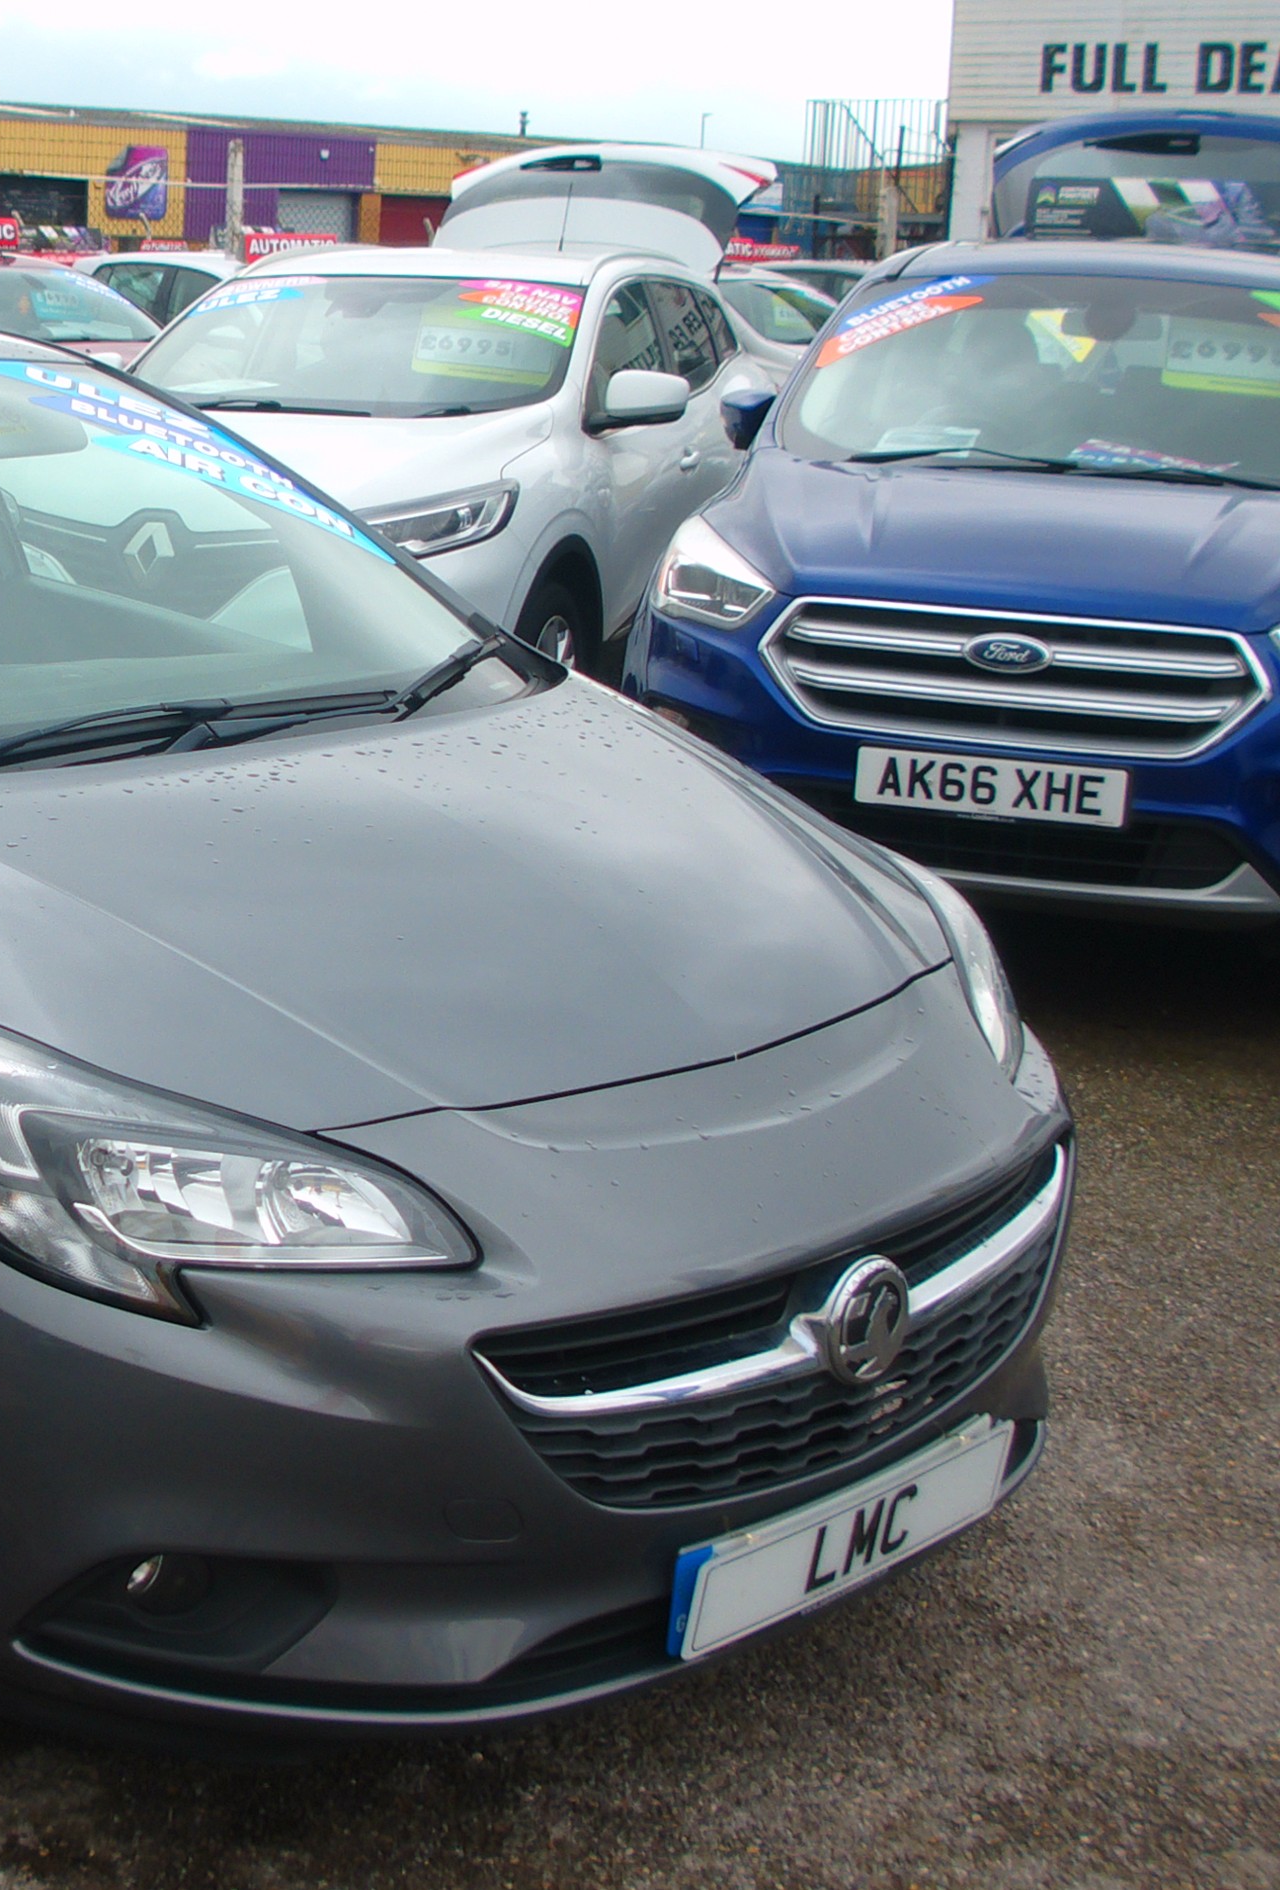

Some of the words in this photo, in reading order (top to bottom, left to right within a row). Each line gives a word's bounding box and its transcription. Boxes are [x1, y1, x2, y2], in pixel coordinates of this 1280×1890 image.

[1040, 42, 1167, 94] FULL
[196, 288, 281, 313] ULEZ
[481, 295, 572, 325] CONTROL
[483, 280, 529, 293] SAT
[530, 288, 578, 305] NAV
[846, 275, 972, 327] BLUETOOTH
[420, 335, 512, 357] £6995
[480, 307, 568, 341] DIESEL
[836, 304, 954, 354] CONTROL
[24, 365, 210, 438] ULEZ
[70, 400, 296, 491] BLUETOOTH
[127, 438, 227, 481] AIR
[238, 472, 355, 538] CON
[983, 641, 1031, 663] Ford
[877, 756, 998, 806] AK66
[1011, 768, 1106, 817] XHE
[804, 1482, 918, 1594] LMC
